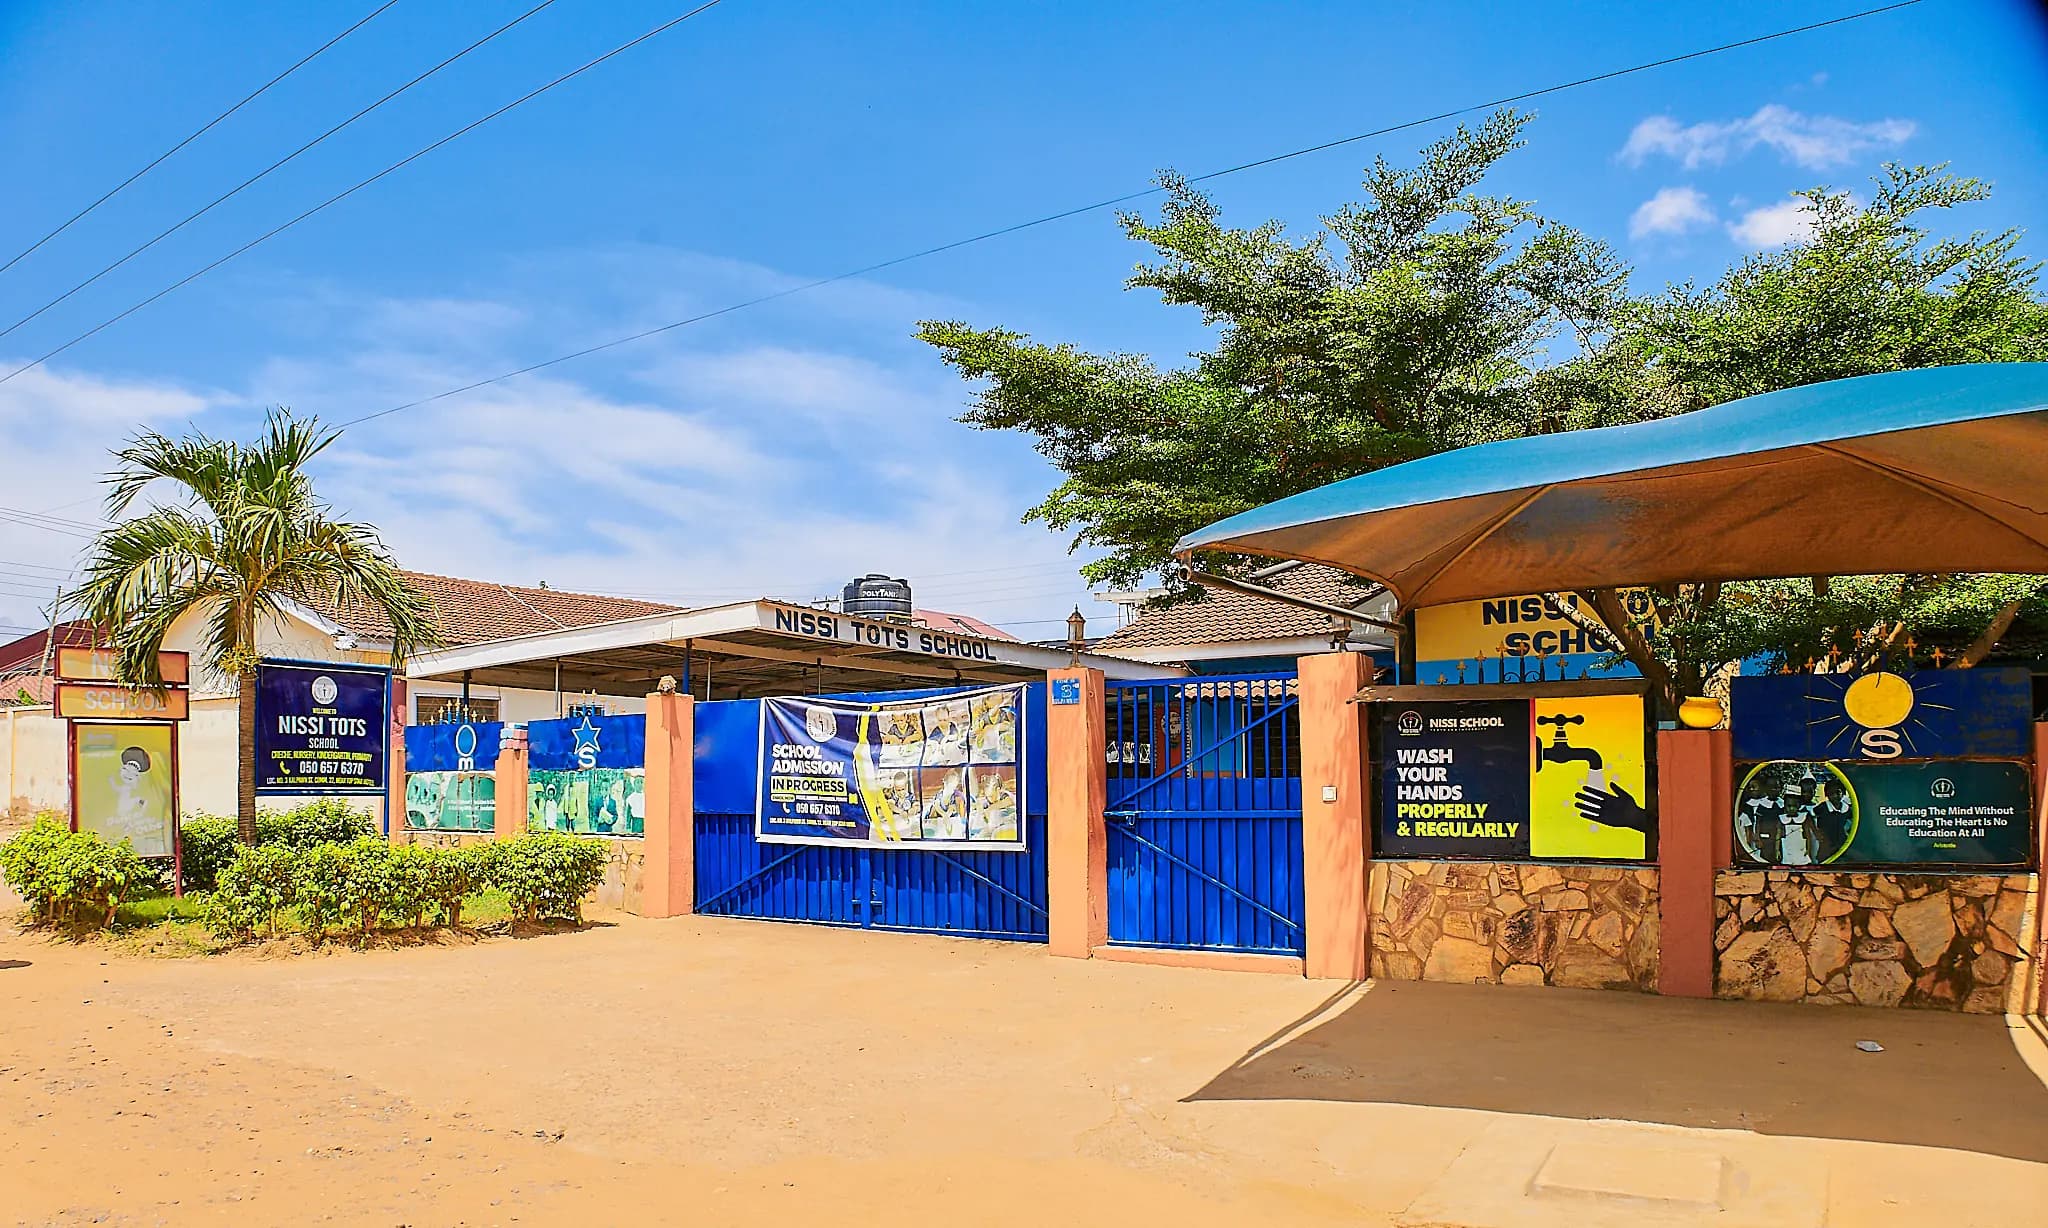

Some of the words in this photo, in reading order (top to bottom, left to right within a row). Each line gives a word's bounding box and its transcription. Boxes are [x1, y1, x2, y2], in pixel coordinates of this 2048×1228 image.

[775, 608, 839, 639] NISSI
[851, 621, 909, 649] TOTS
[920, 633, 997, 661] SCHOOL
[84, 690, 167, 712] SCHOOL
[278, 715, 324, 735] NISSI
[328, 717, 367, 737] TOTS
[1429, 718, 1457, 728] NISSI
[1459, 717, 1504, 728] SCHOOL
[308, 737, 340, 749] SCHOOL
[1860, 729, 1903, 759] S
[577, 747, 597, 768] S
[772, 744, 823, 760] SCHOOL
[1396, 748, 1453, 764] WASH
[299, 760, 318, 774] 050
[319, 761, 339, 774] 657
[340, 761, 364, 775] 6370
[771, 760, 845, 776] ADMISSION
[1396, 766, 1448, 782] YOUR
[772, 779, 784, 790] IN
[786, 779, 844, 793] PROGRESS
[1397, 785, 1463, 801] HANDS
[1397, 803, 1488, 819] PROPERLY
[1879, 806, 1928, 818] Educating
[1928, 806, 1946, 816] The
[1948, 806, 1973, 816] Mind
[1974, 806, 2014, 816] Without
[1396, 821, 1411, 837] &
[1415, 822, 1520, 838] REGULARLY
[1886, 817, 1934, 828] Educating
[1935, 817, 1953, 827] The
[1954, 817, 1982, 827] Heart
[1983, 817, 1992, 827] Is
[1993, 817, 2008, 827] No
[1908, 828, 1957, 838] Education
[1958, 828, 1970, 838] At
[1971, 828, 1985, 838] All
